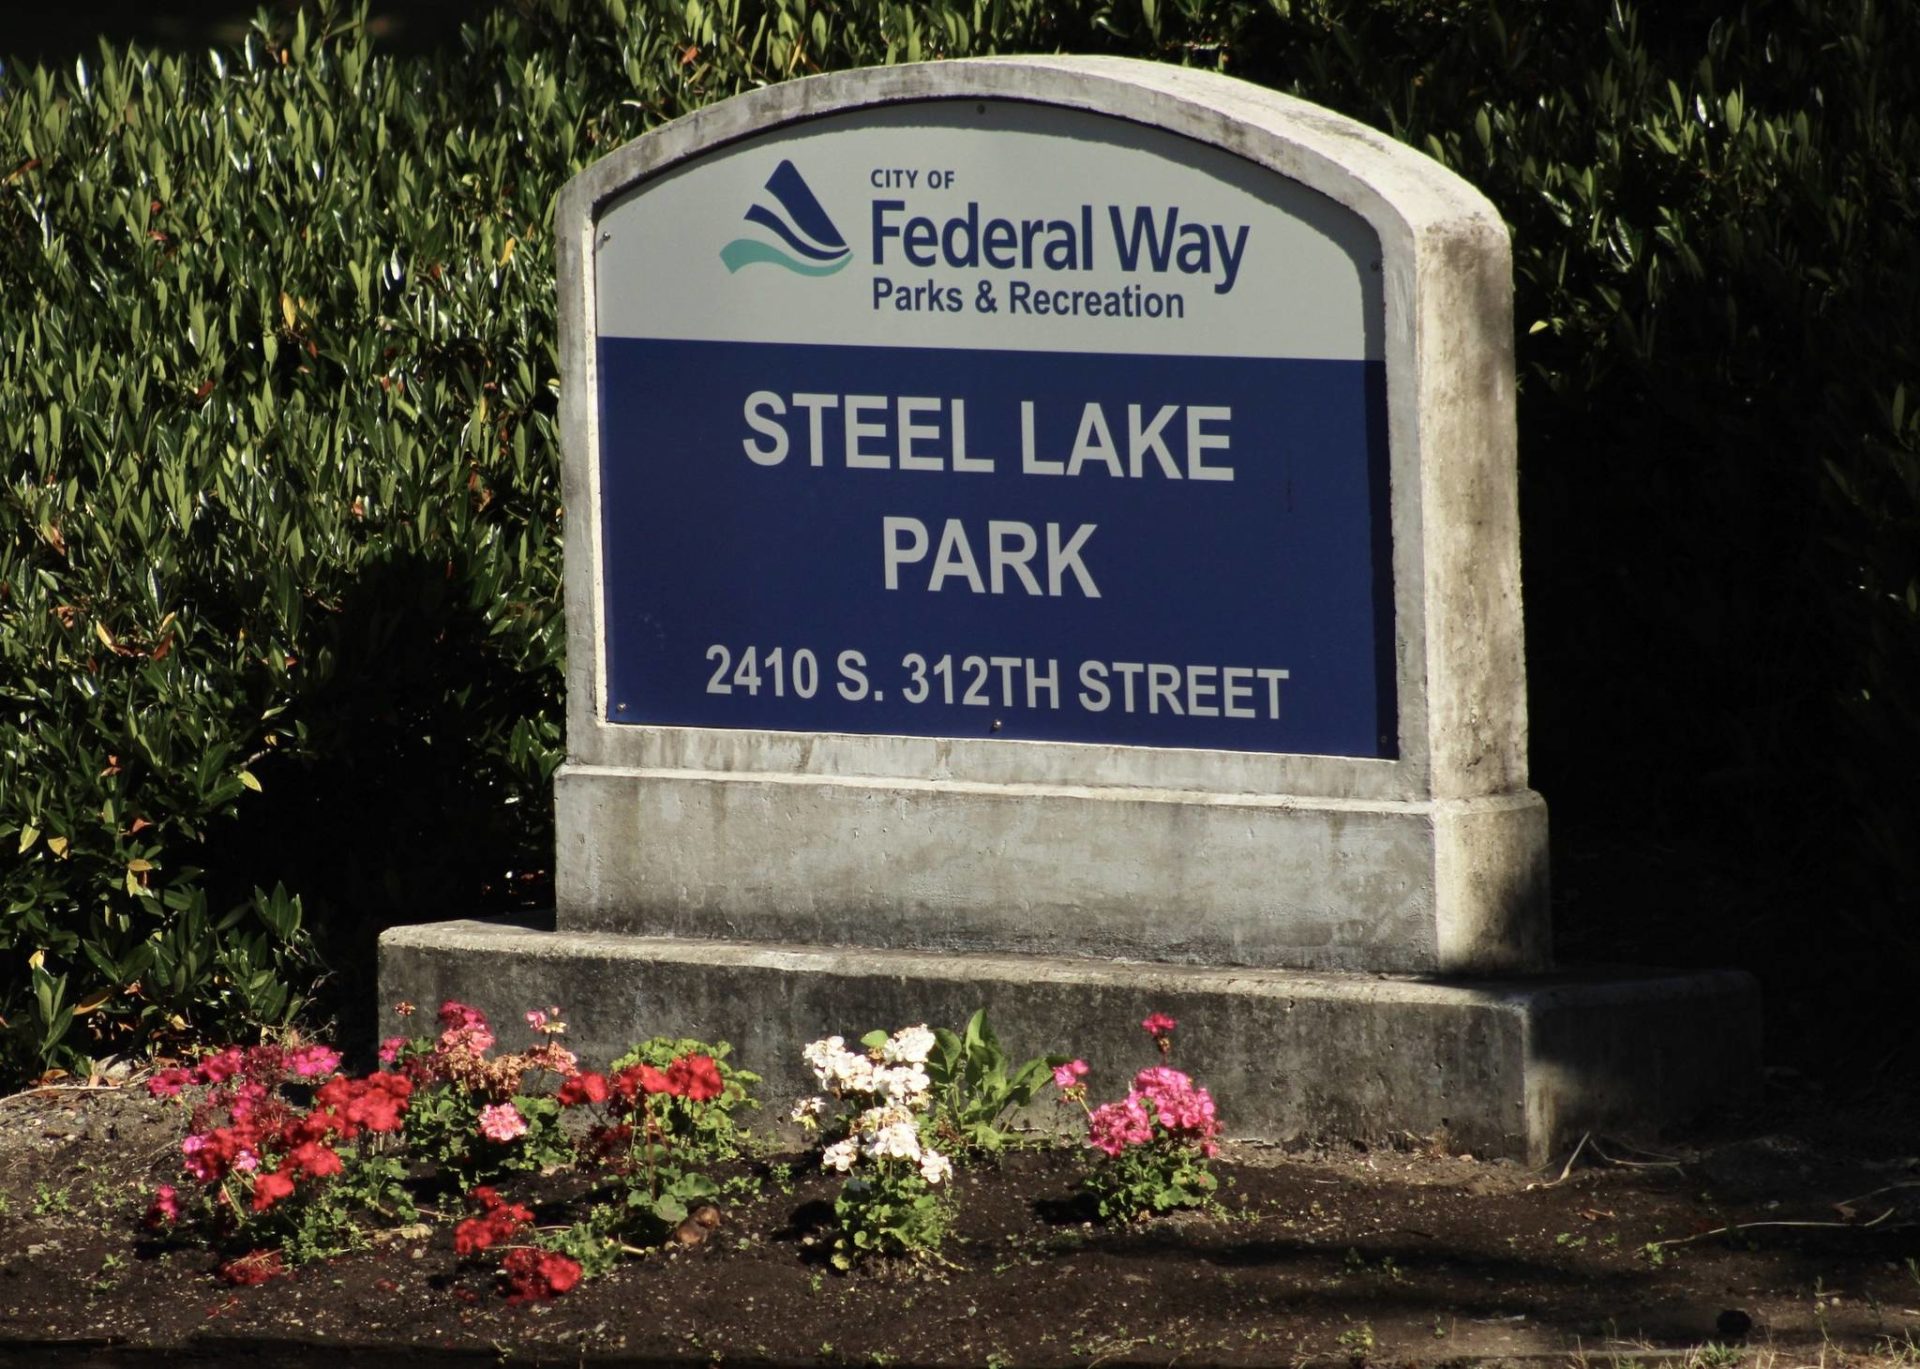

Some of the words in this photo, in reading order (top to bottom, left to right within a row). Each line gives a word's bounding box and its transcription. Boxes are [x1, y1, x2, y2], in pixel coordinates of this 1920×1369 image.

[871, 169, 918, 188] CITY
[928, 170, 954, 189] OF
[872, 200, 1093, 270] Federal
[1108, 205, 1250, 294] Way
[873, 277, 963, 312] Parks
[975, 280, 997, 313] &
[1010, 281, 1183, 318] Recreation
[743, 391, 994, 472] STEEL
[1021, 401, 1234, 481] LAKE
[884, 517, 1101, 597] PARK
[707, 645, 818, 698] 2410
[837, 650, 883, 701] S.
[902, 653, 1059, 708] 312TH
[1079, 661, 1289, 719] STREET
